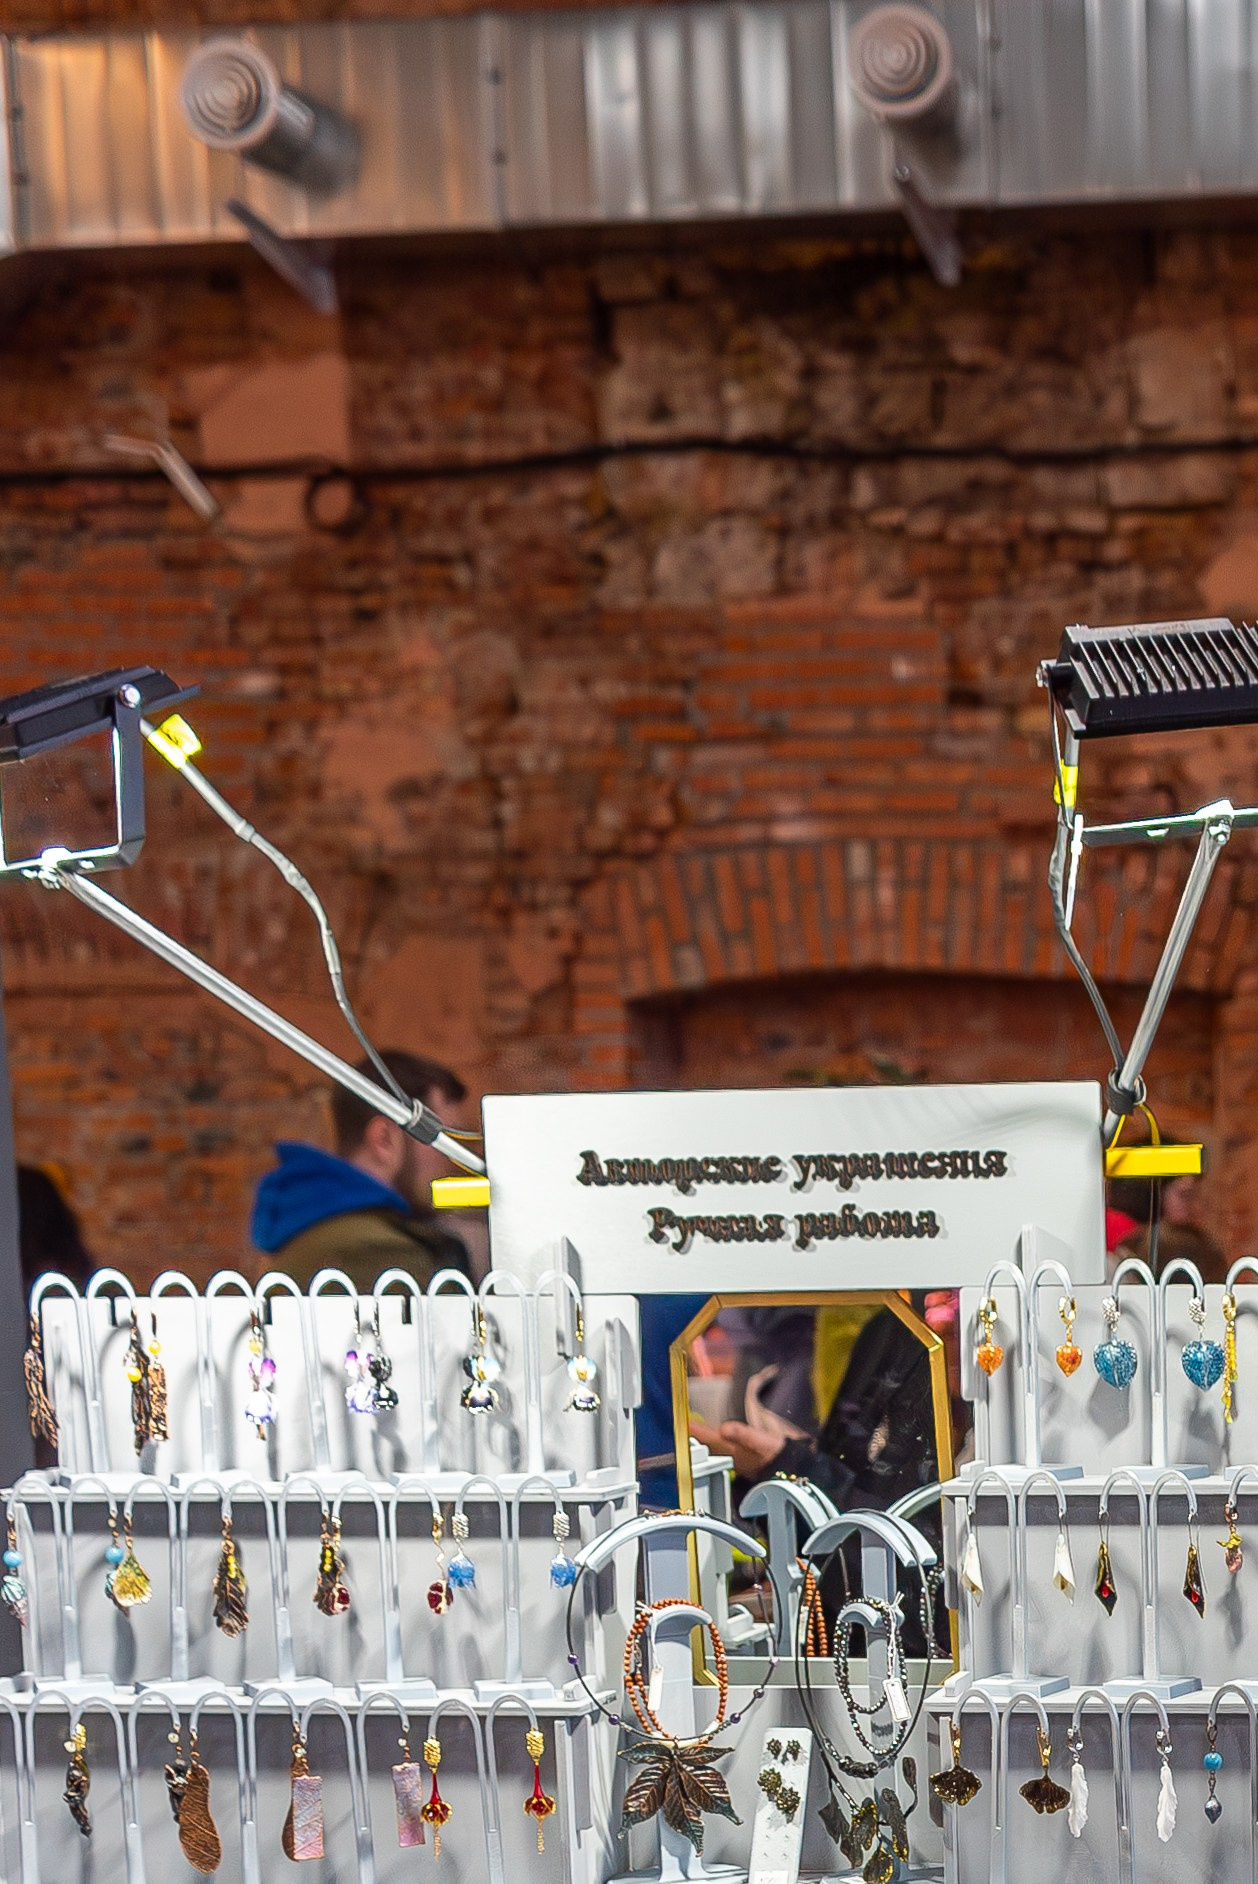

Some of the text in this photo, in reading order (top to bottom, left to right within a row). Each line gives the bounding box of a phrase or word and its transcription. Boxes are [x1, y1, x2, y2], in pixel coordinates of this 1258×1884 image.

[576, 1150, 1009, 1195] Авторские украшения
[647, 1203, 940, 1251] Ручная работа
